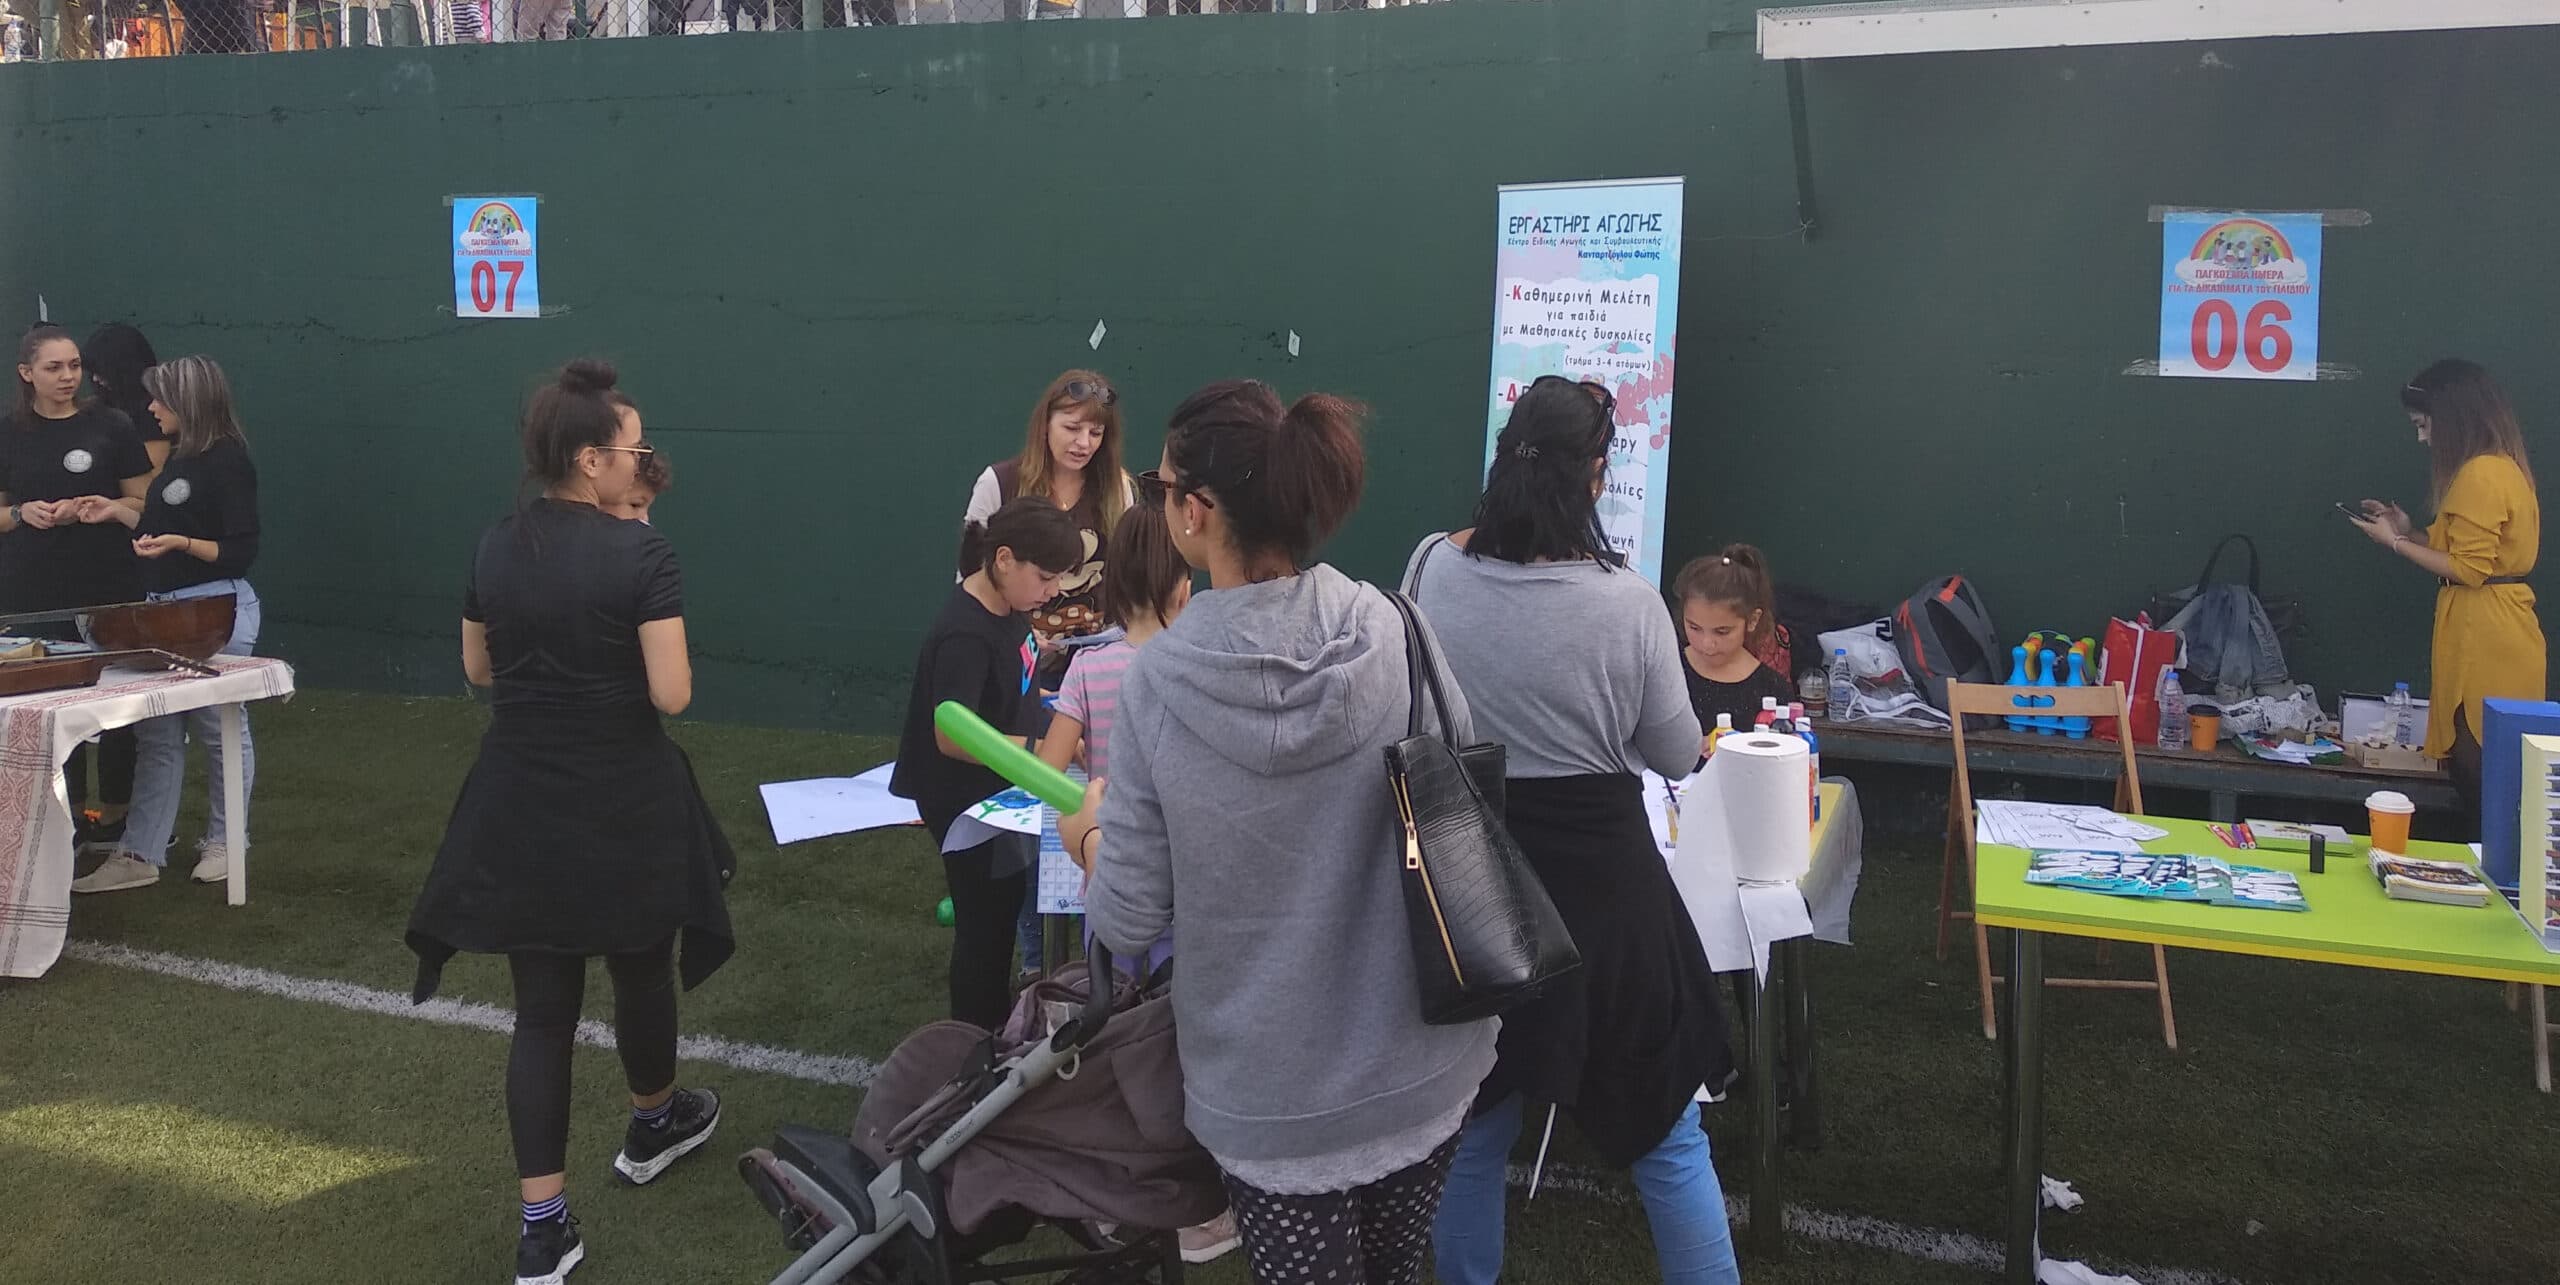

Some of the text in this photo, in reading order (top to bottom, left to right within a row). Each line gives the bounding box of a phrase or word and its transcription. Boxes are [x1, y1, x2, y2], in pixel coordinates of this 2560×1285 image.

[1509, 213, 1662, 234] ΕΡΓΑΣΤΗΡΙ ΑΓΩΓΗΣ
[1560, 236, 1586, 247] Αγωγής
[1634, 250, 1660, 261] Φώτης
[471, 260, 525, 313] 07
[1505, 285, 1651, 306] -Καθημερινή Μελέτη
[1547, 309, 1607, 322] για παιδιά
[1503, 324, 1652, 344] με Μαθησιακές δυσκολίες
[2191, 298, 2293, 373] 06
[1596, 357, 1612, 367] 3-4
